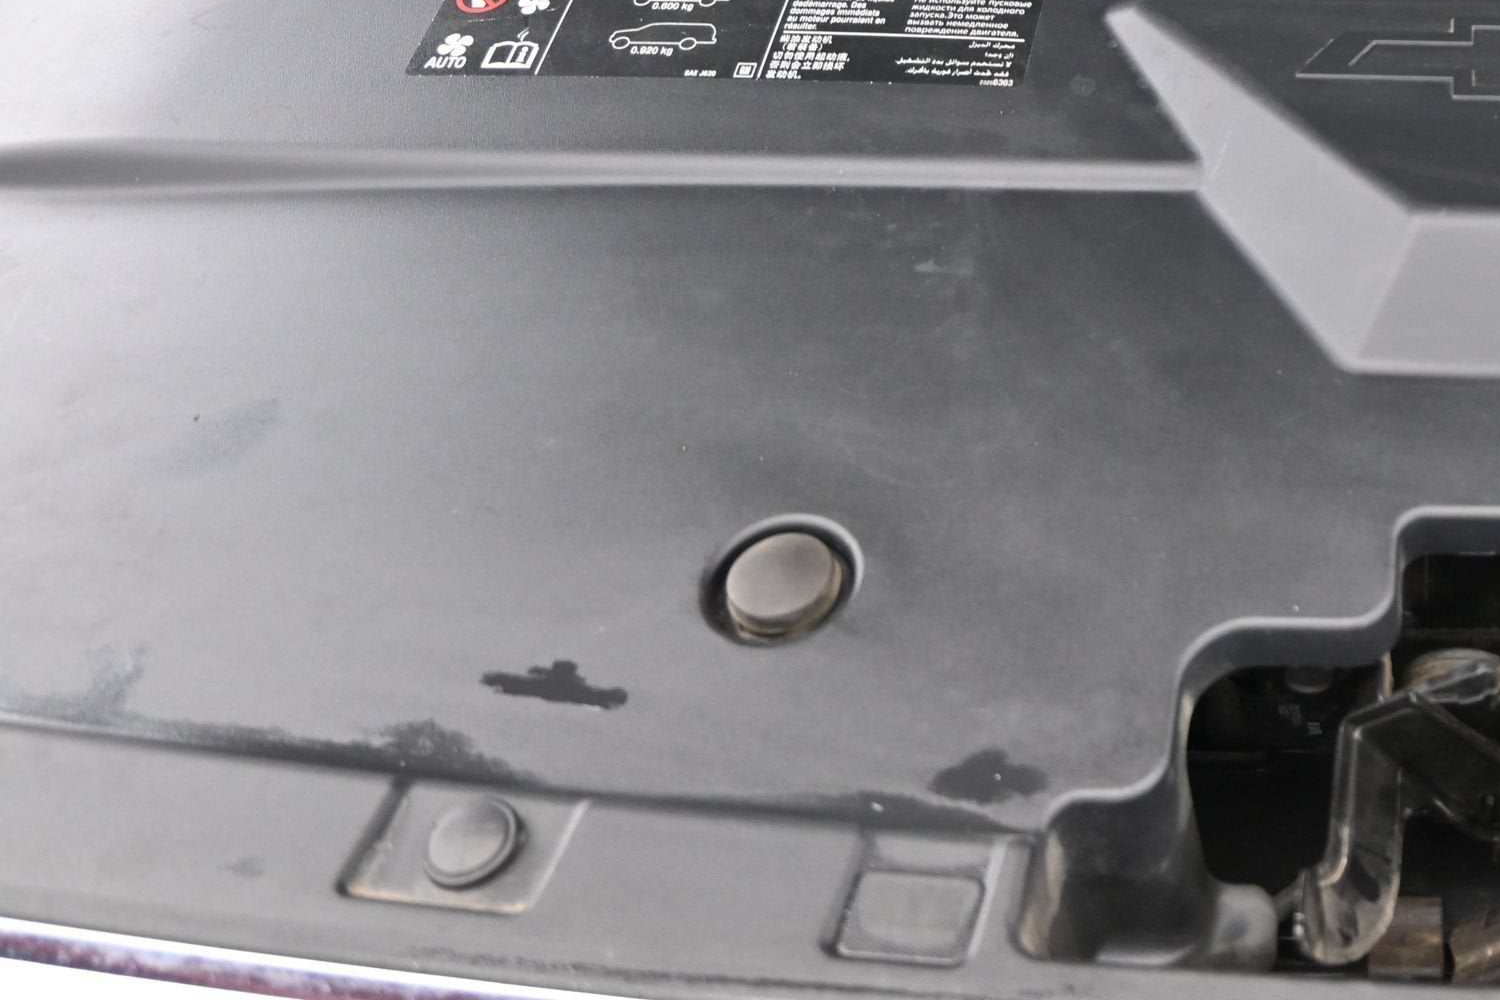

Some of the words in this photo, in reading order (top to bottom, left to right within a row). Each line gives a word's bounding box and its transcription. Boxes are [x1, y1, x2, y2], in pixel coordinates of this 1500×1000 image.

[681, 2, 694, 12] kg
[851, 1, 867, 9] Des
[988, 0, 1033, 8] пусковые
[790, 8, 835, 16] dommages
[912, 4, 957, 12] жидкости
[977, 7, 1025, 16] холодного
[946, 21, 1009, 29] немедленное
[905, 26, 969, 35] повреждение
[660, 47, 674, 56] kg
[424, 56, 467, 69] AUTO
